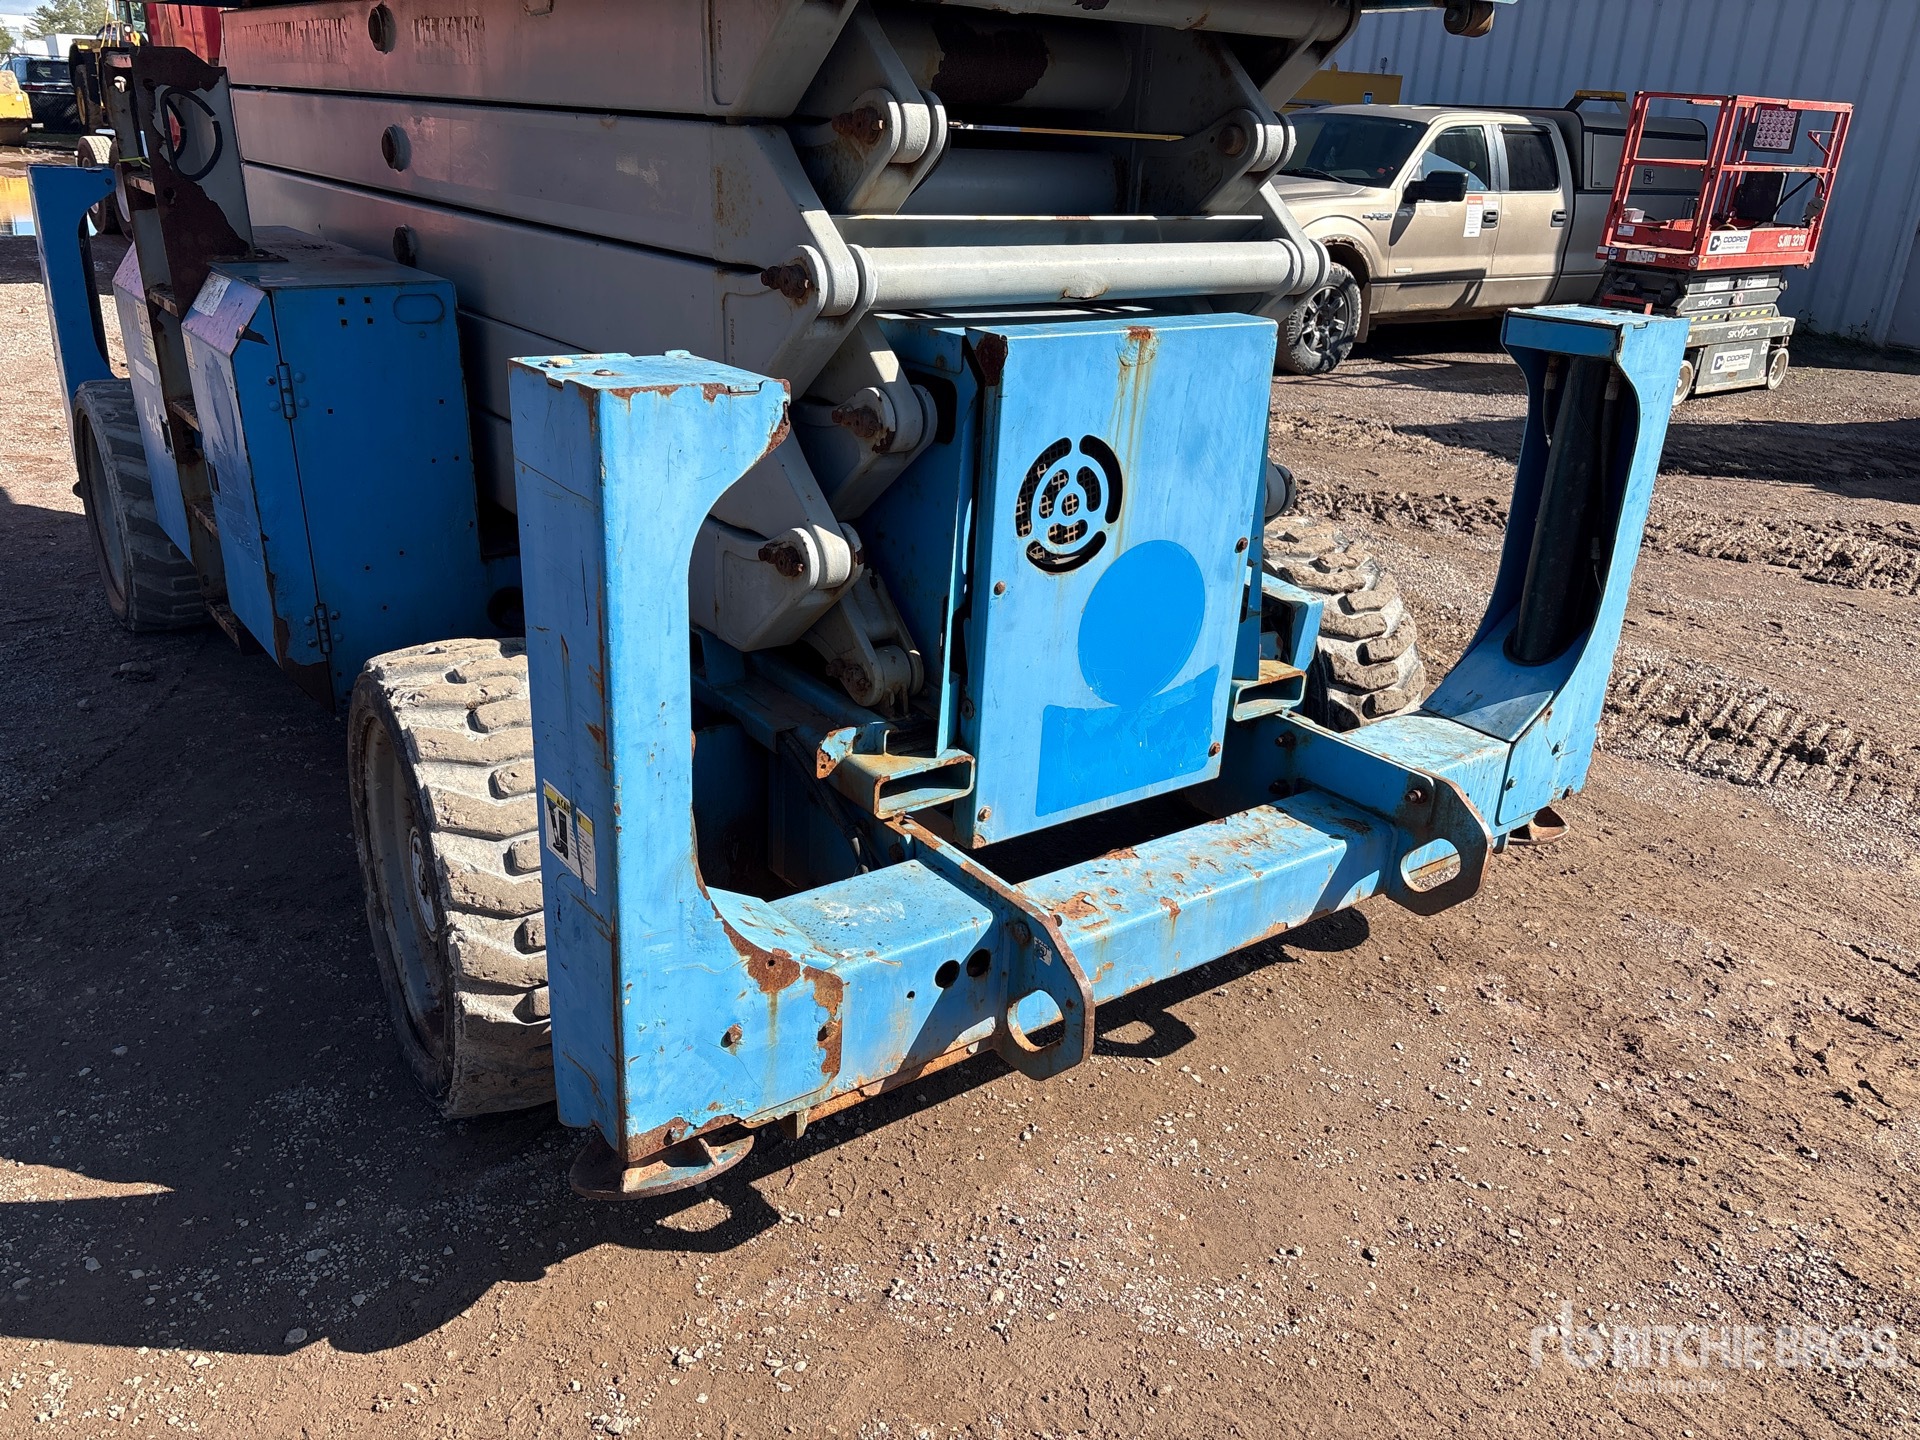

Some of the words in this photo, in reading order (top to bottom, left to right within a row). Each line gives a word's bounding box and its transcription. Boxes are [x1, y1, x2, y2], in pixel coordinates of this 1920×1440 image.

[1723, 235, 1749, 244] COOPER
[1791, 233, 1807, 247] 3219
[1697, 296, 1723, 308] SKYJACK
[1727, 324, 1759, 339] SKYJACK
[1726, 353, 1750, 363] COOPER
